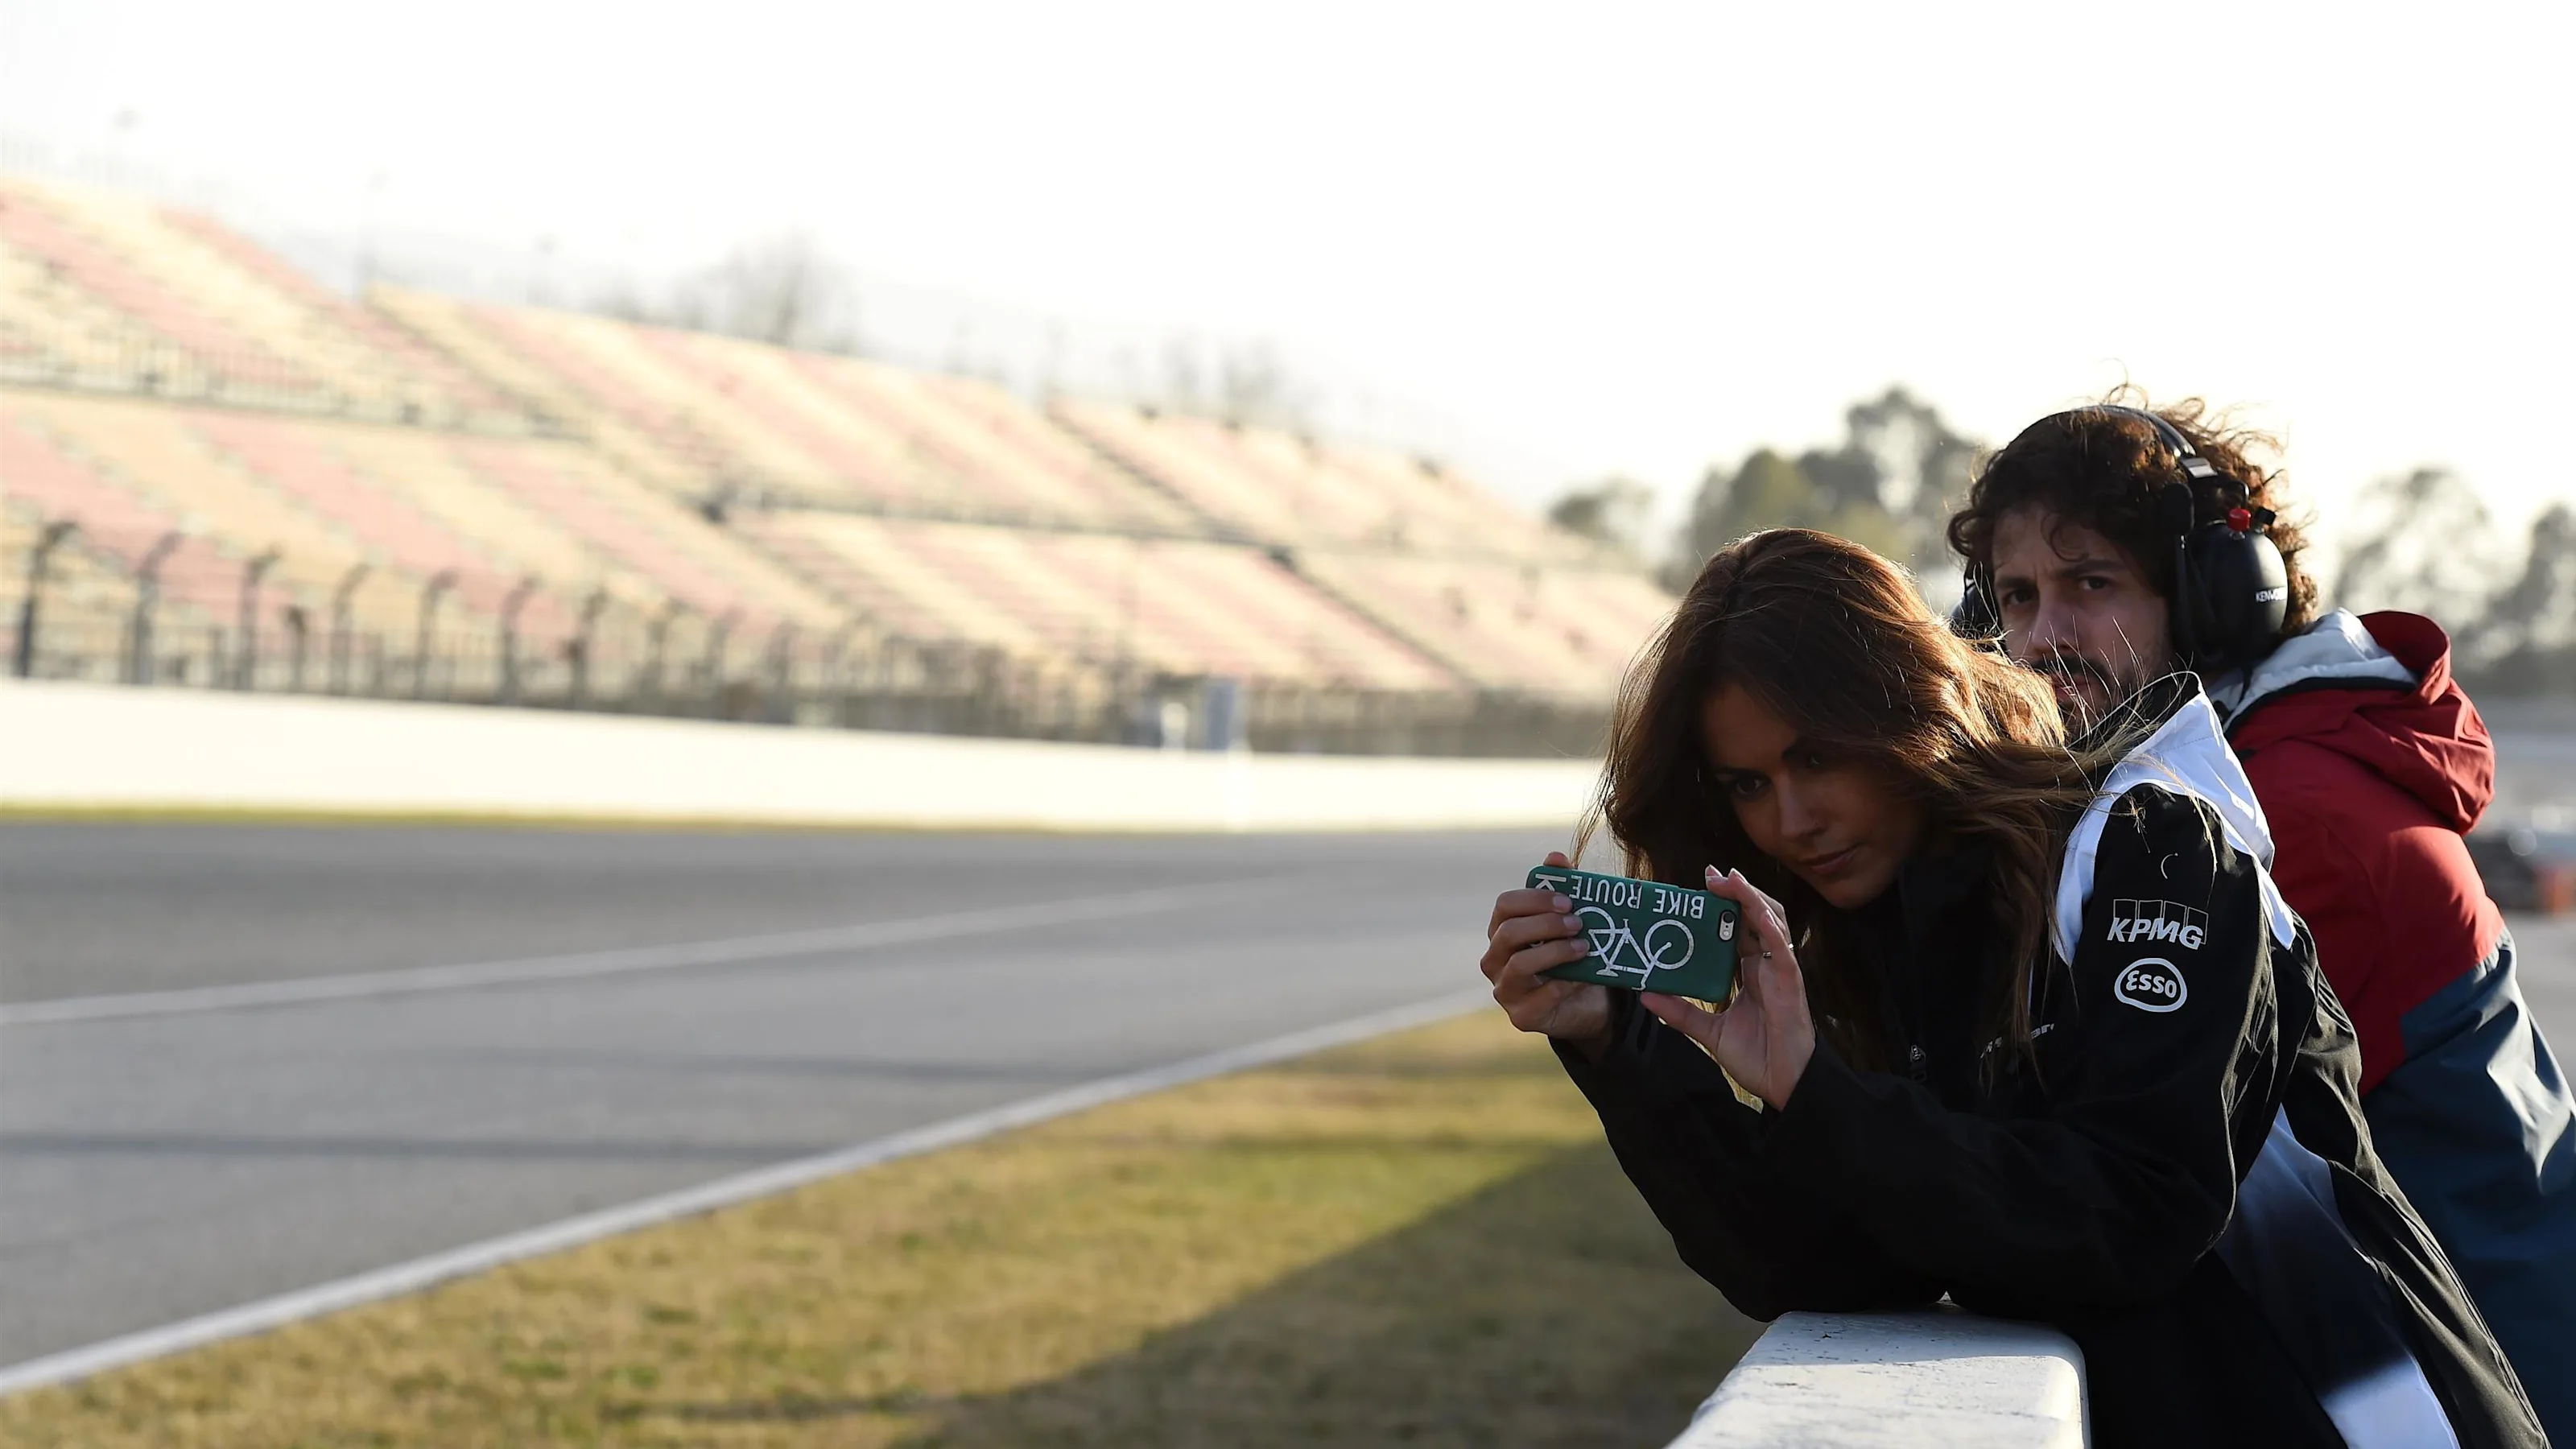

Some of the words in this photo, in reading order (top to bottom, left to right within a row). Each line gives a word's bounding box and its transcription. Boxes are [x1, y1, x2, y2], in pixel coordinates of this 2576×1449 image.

[1568, 874, 1642, 910] ROUTE
[1653, 888, 1705, 919] BIKE
[2107, 917, 2203, 950] KPMG
